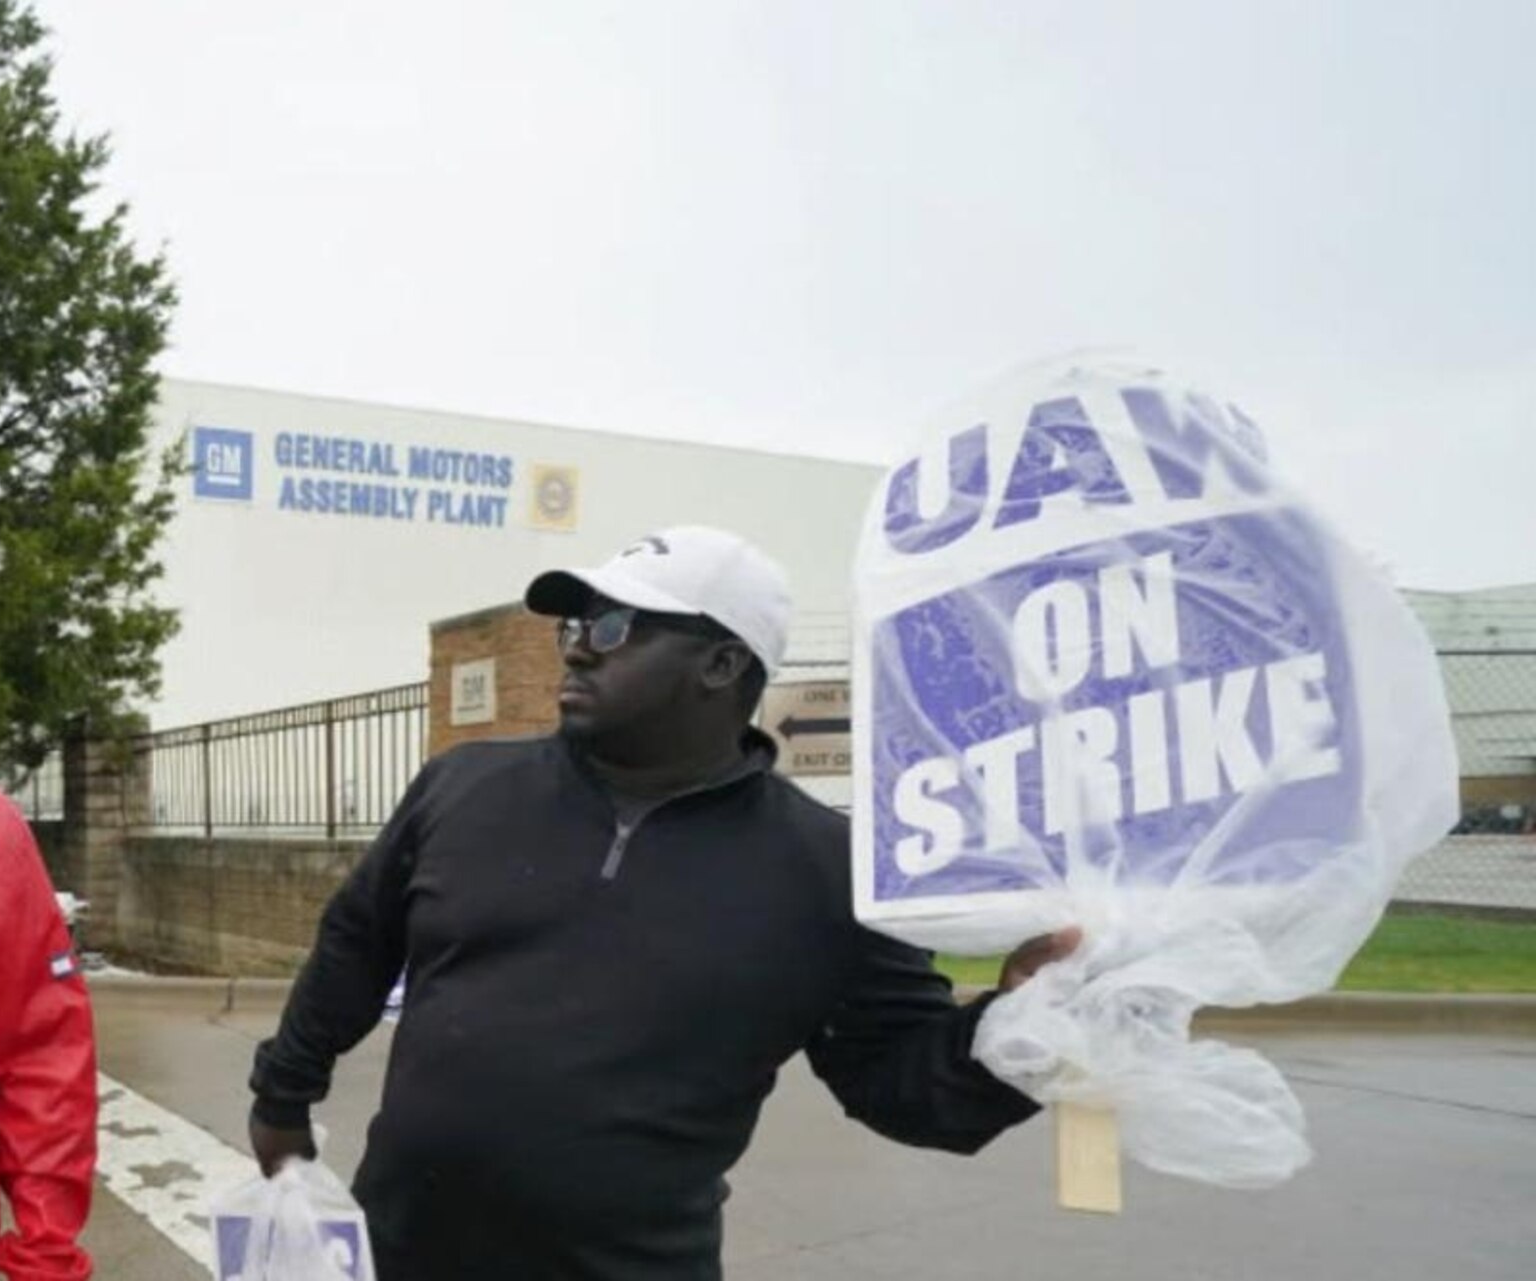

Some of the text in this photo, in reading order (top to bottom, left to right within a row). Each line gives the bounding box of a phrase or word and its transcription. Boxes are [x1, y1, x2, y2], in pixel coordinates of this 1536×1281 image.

[206, 442, 242, 474] GM
[274, 431, 514, 489] GENERAL MOTORS
[883, 387, 1276, 555] UAW
[278, 475, 508, 528] ASSEMBLY PLANT
[1012, 551, 1181, 703] ON
[792, 752, 828, 768] EXIT
[892, 652, 1342, 877] STRIKE
